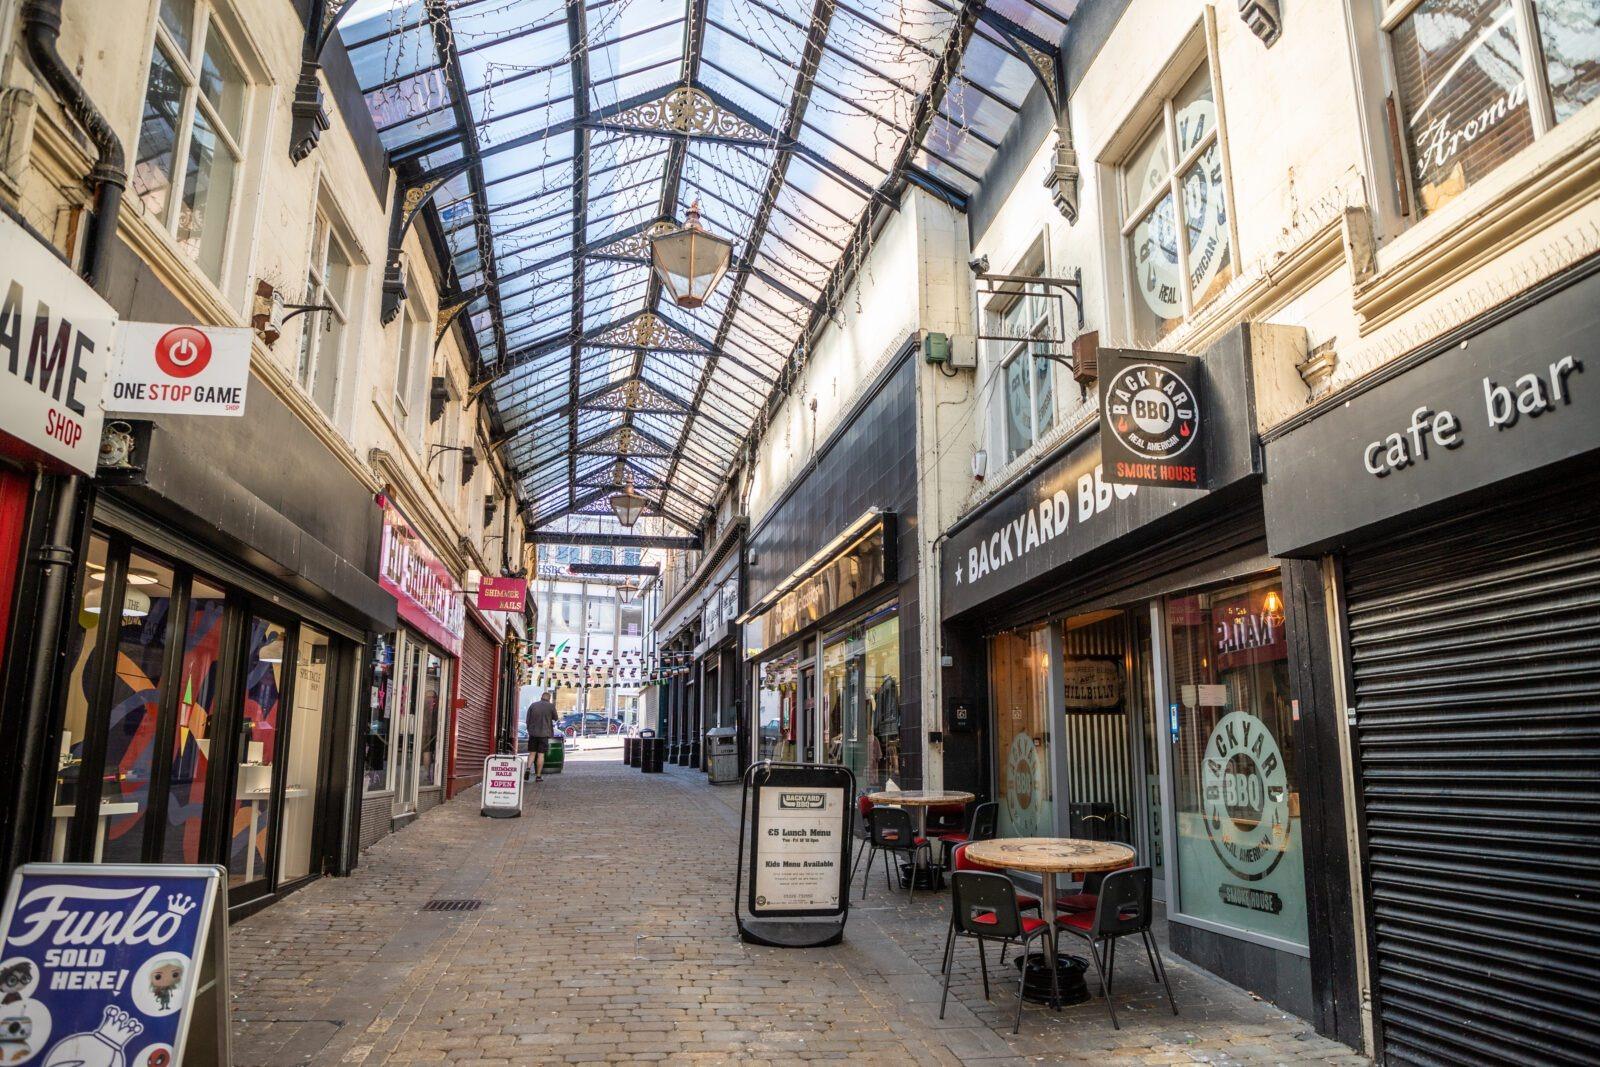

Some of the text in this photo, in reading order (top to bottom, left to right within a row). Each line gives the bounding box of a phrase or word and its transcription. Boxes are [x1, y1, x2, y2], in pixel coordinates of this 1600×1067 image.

[1415, 82, 1527, 180] Aroma
[113, 382, 242, 404] ONE STOP GAME
[1112, 370, 1192, 420] BACKYARD
[225, 403, 240, 412] SHOP
[1135, 399, 1170, 423] BBQ
[1363, 355, 1575, 475] cafe bar
[45, 408, 83, 450] SHOP
[1128, 432, 1180, 452] REAL AMERICAN
[1116, 462, 1197, 483] SMOKE HOUSE
[968, 491, 1070, 585] BACKYARD
[538, 564, 566, 577] HSBC
[484, 588, 519, 599] SHIMMER
[499, 601, 522, 610] NAILS
[1226, 773, 1262, 813] BBQ
[782, 828, 807, 837] Lunch
[810, 828, 832, 837] Menu
[765, 860, 834, 868] Kids Menu Available
[1226, 885, 1275, 912] SMOKE HOUSE
[7, 884, 184, 947] Funko
[44, 949, 106, 968] SOLD
[50, 969, 130, 997] HERE!
